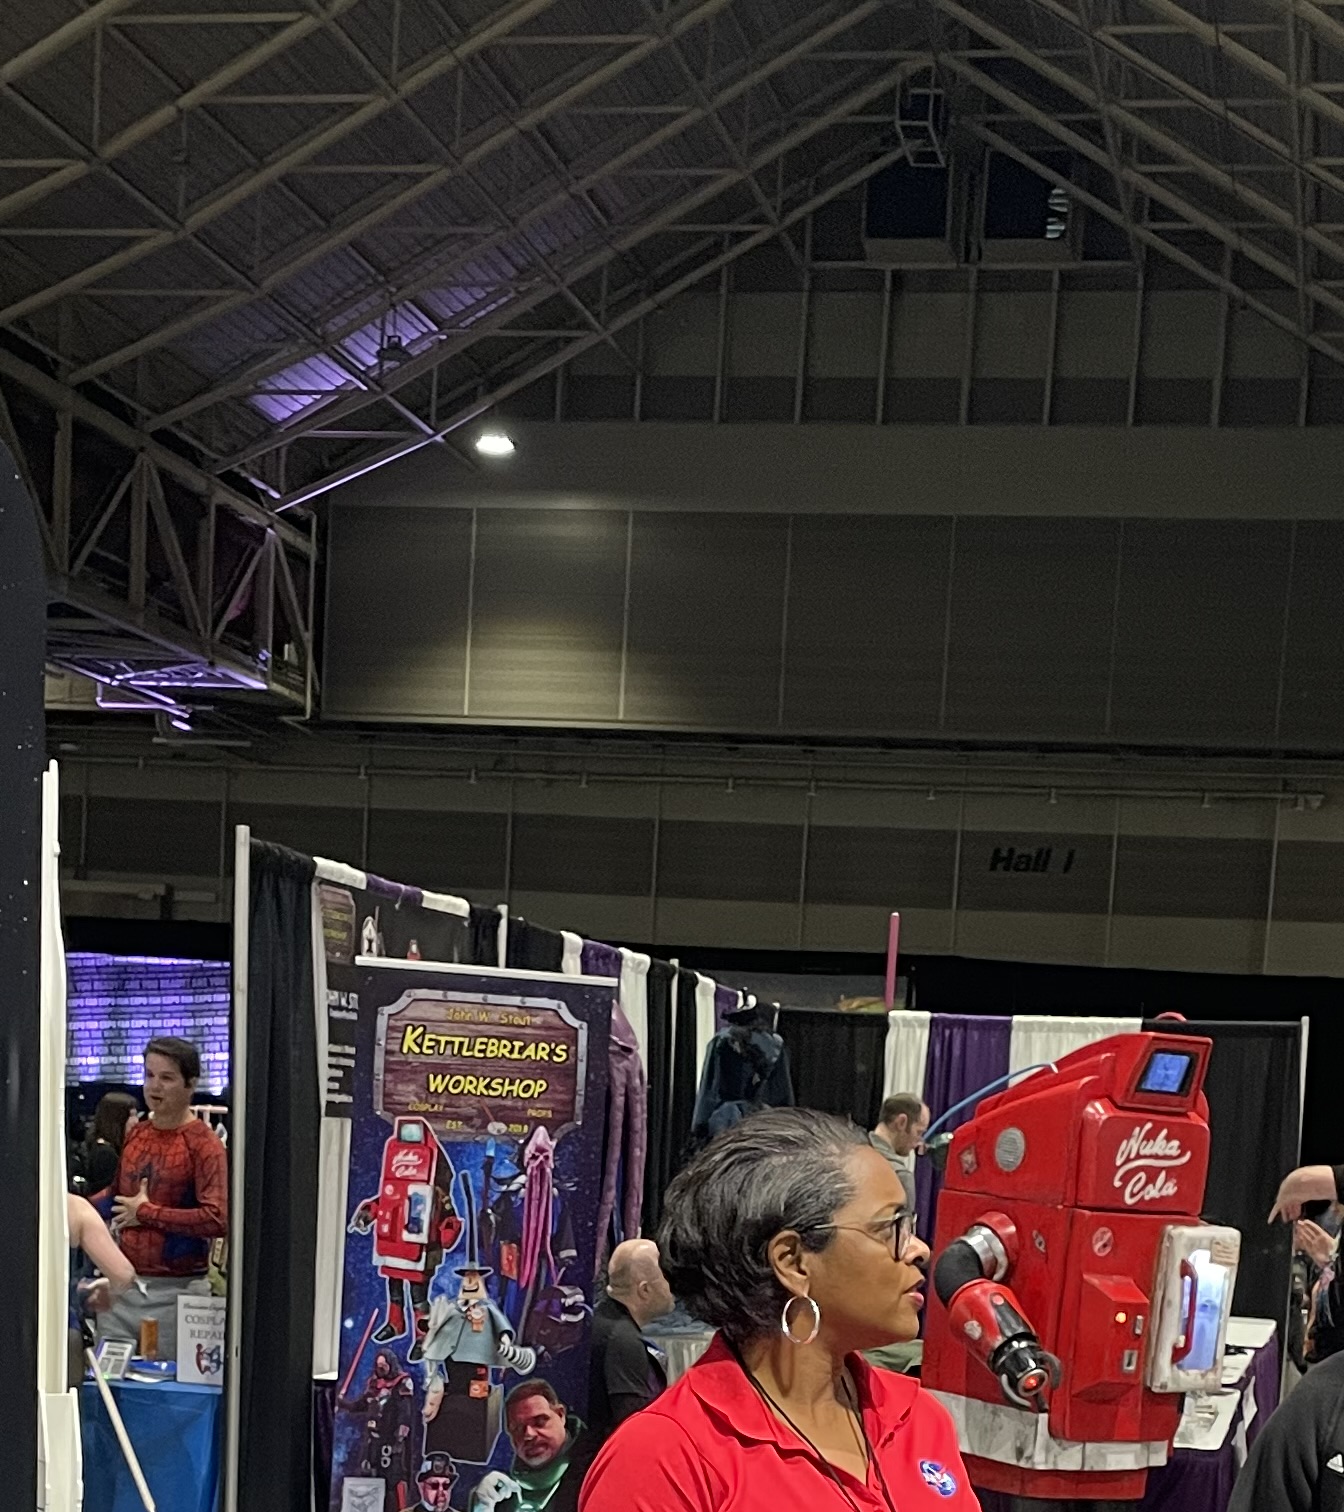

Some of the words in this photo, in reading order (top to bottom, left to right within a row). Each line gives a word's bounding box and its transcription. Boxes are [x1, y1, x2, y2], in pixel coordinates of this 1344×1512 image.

[989, 847, 1052, 873] Hall
[402, 1024, 568, 1063] KETTLEBRIAR'S
[428, 1073, 548, 1099] WORKSHOP
[1115, 1121, 1182, 1167] Nuka
[1124, 1170, 1178, 1206] Cola
